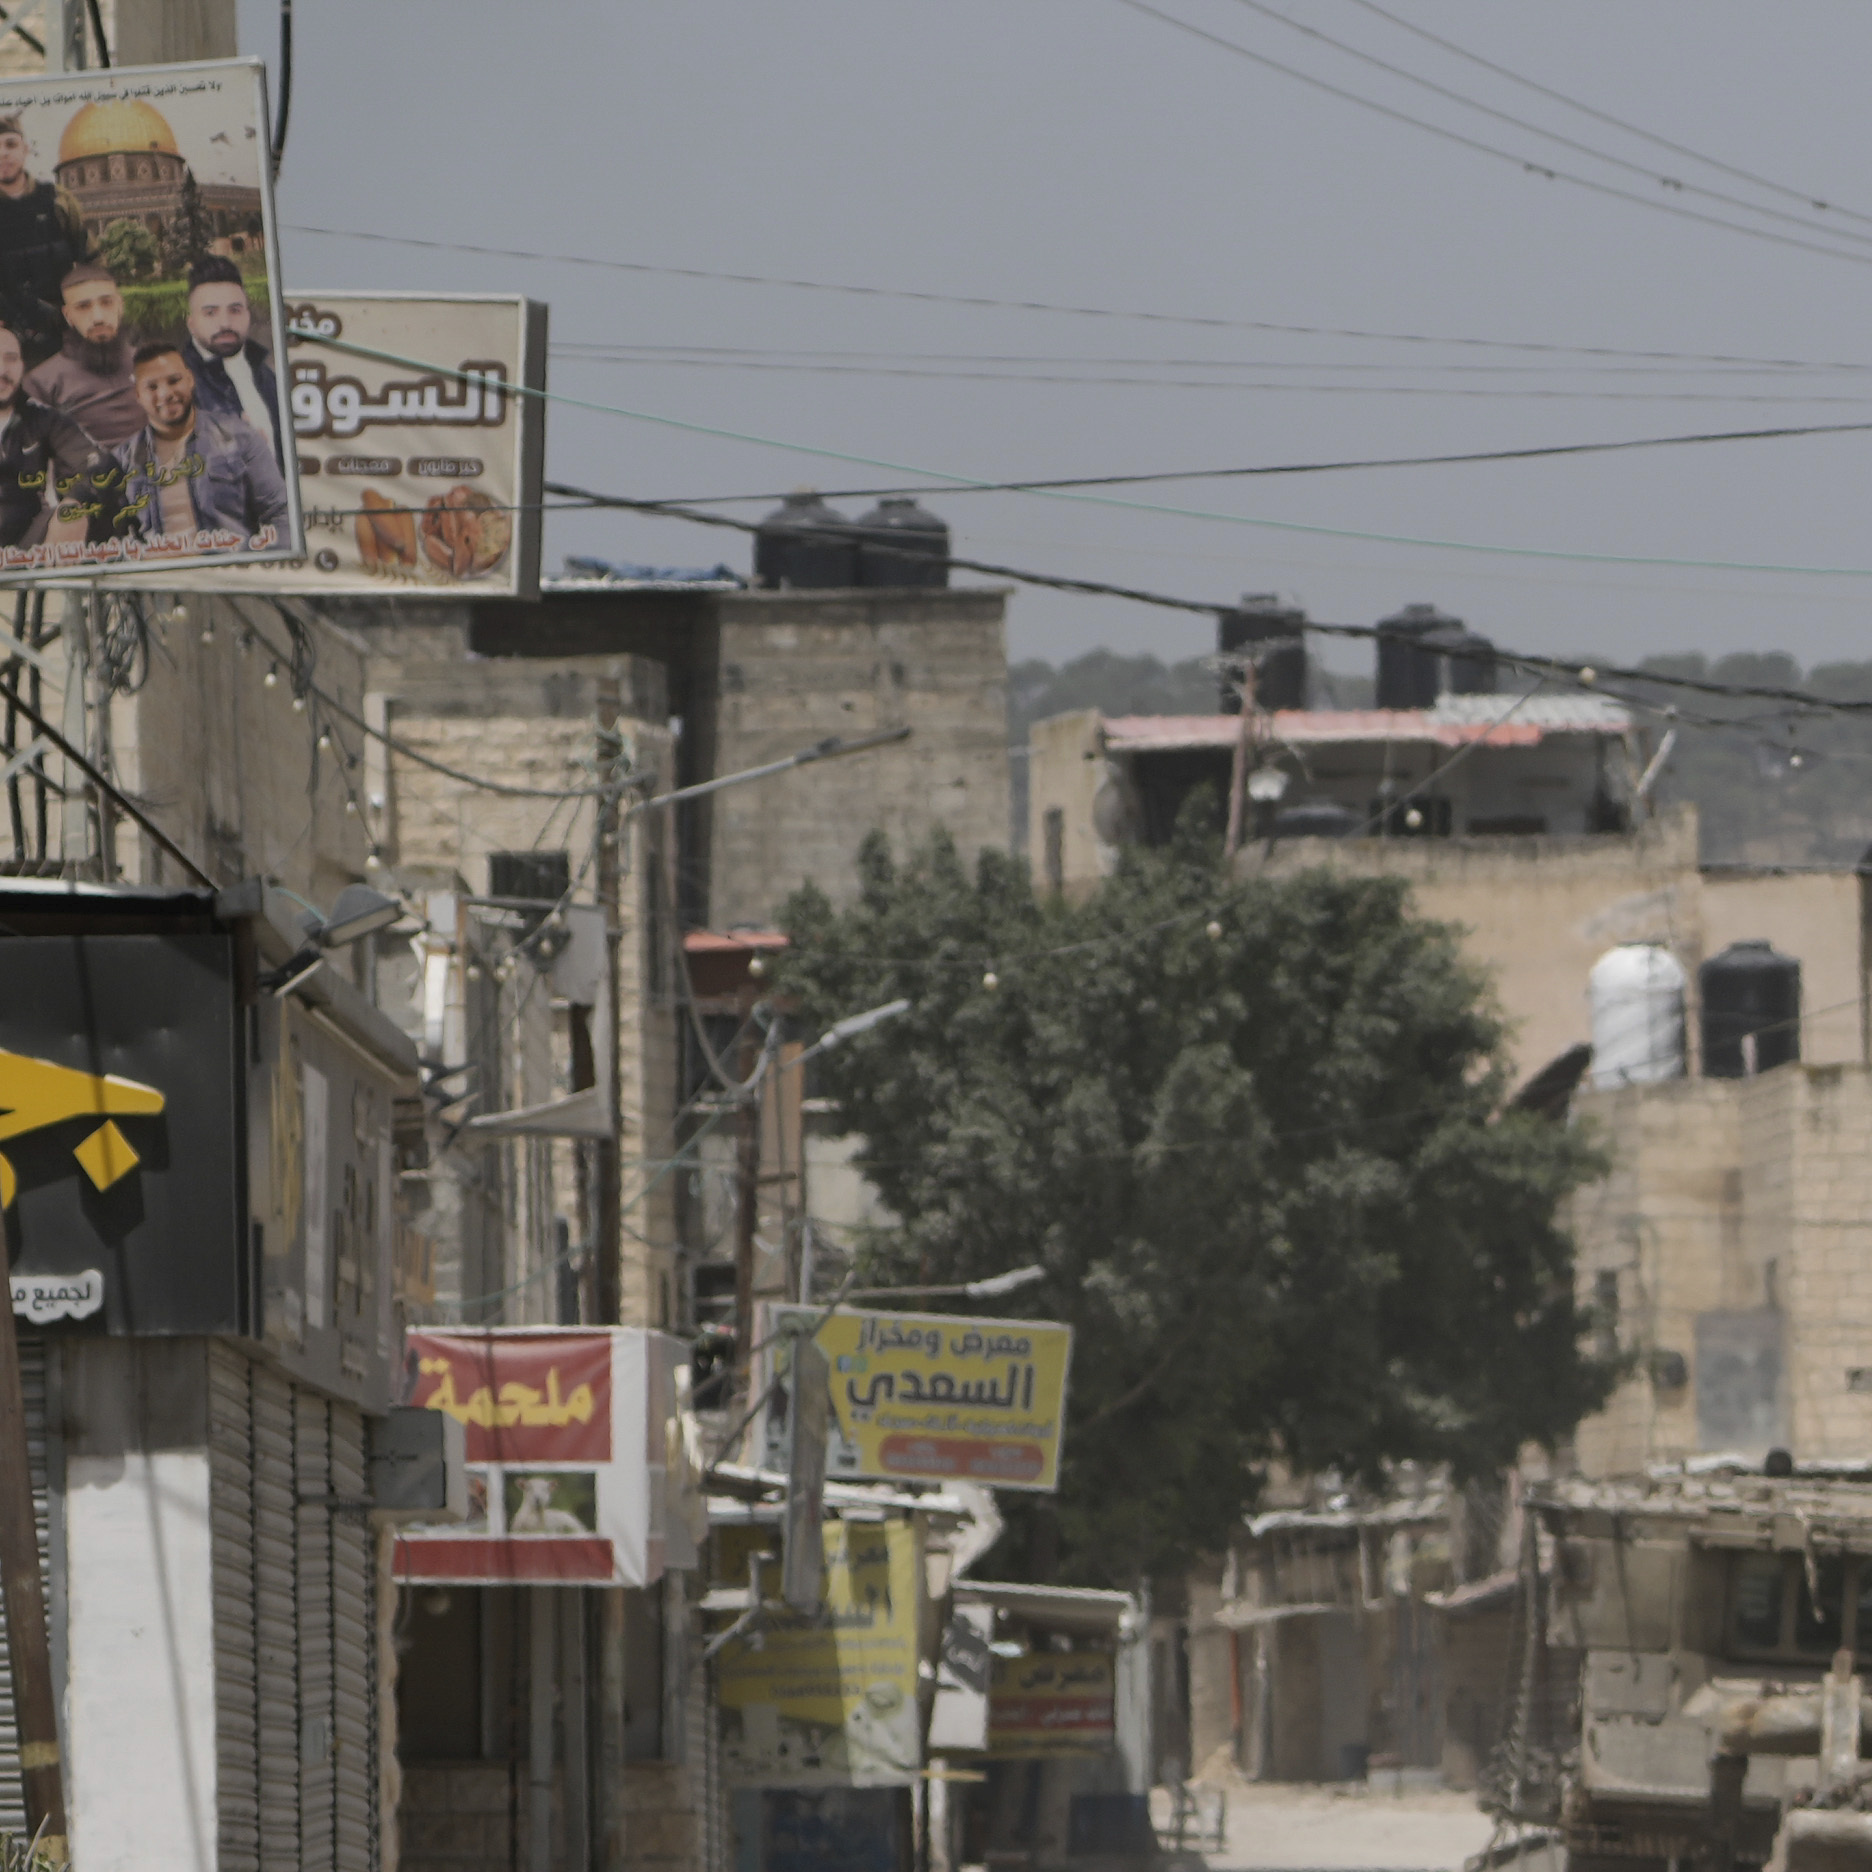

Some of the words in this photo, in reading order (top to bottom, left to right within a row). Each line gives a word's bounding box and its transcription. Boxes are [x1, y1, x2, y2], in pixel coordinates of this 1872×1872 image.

[291, 367, 500, 433] السوق
[197, 528, 245, 552] جنات
[32, 1279, 92, 1313] لجميع
[950, 1325, 1032, 1361] معرض
[418, 1357, 594, 1431] ملحمة
[846, 1362, 1035, 1422] السعدي
